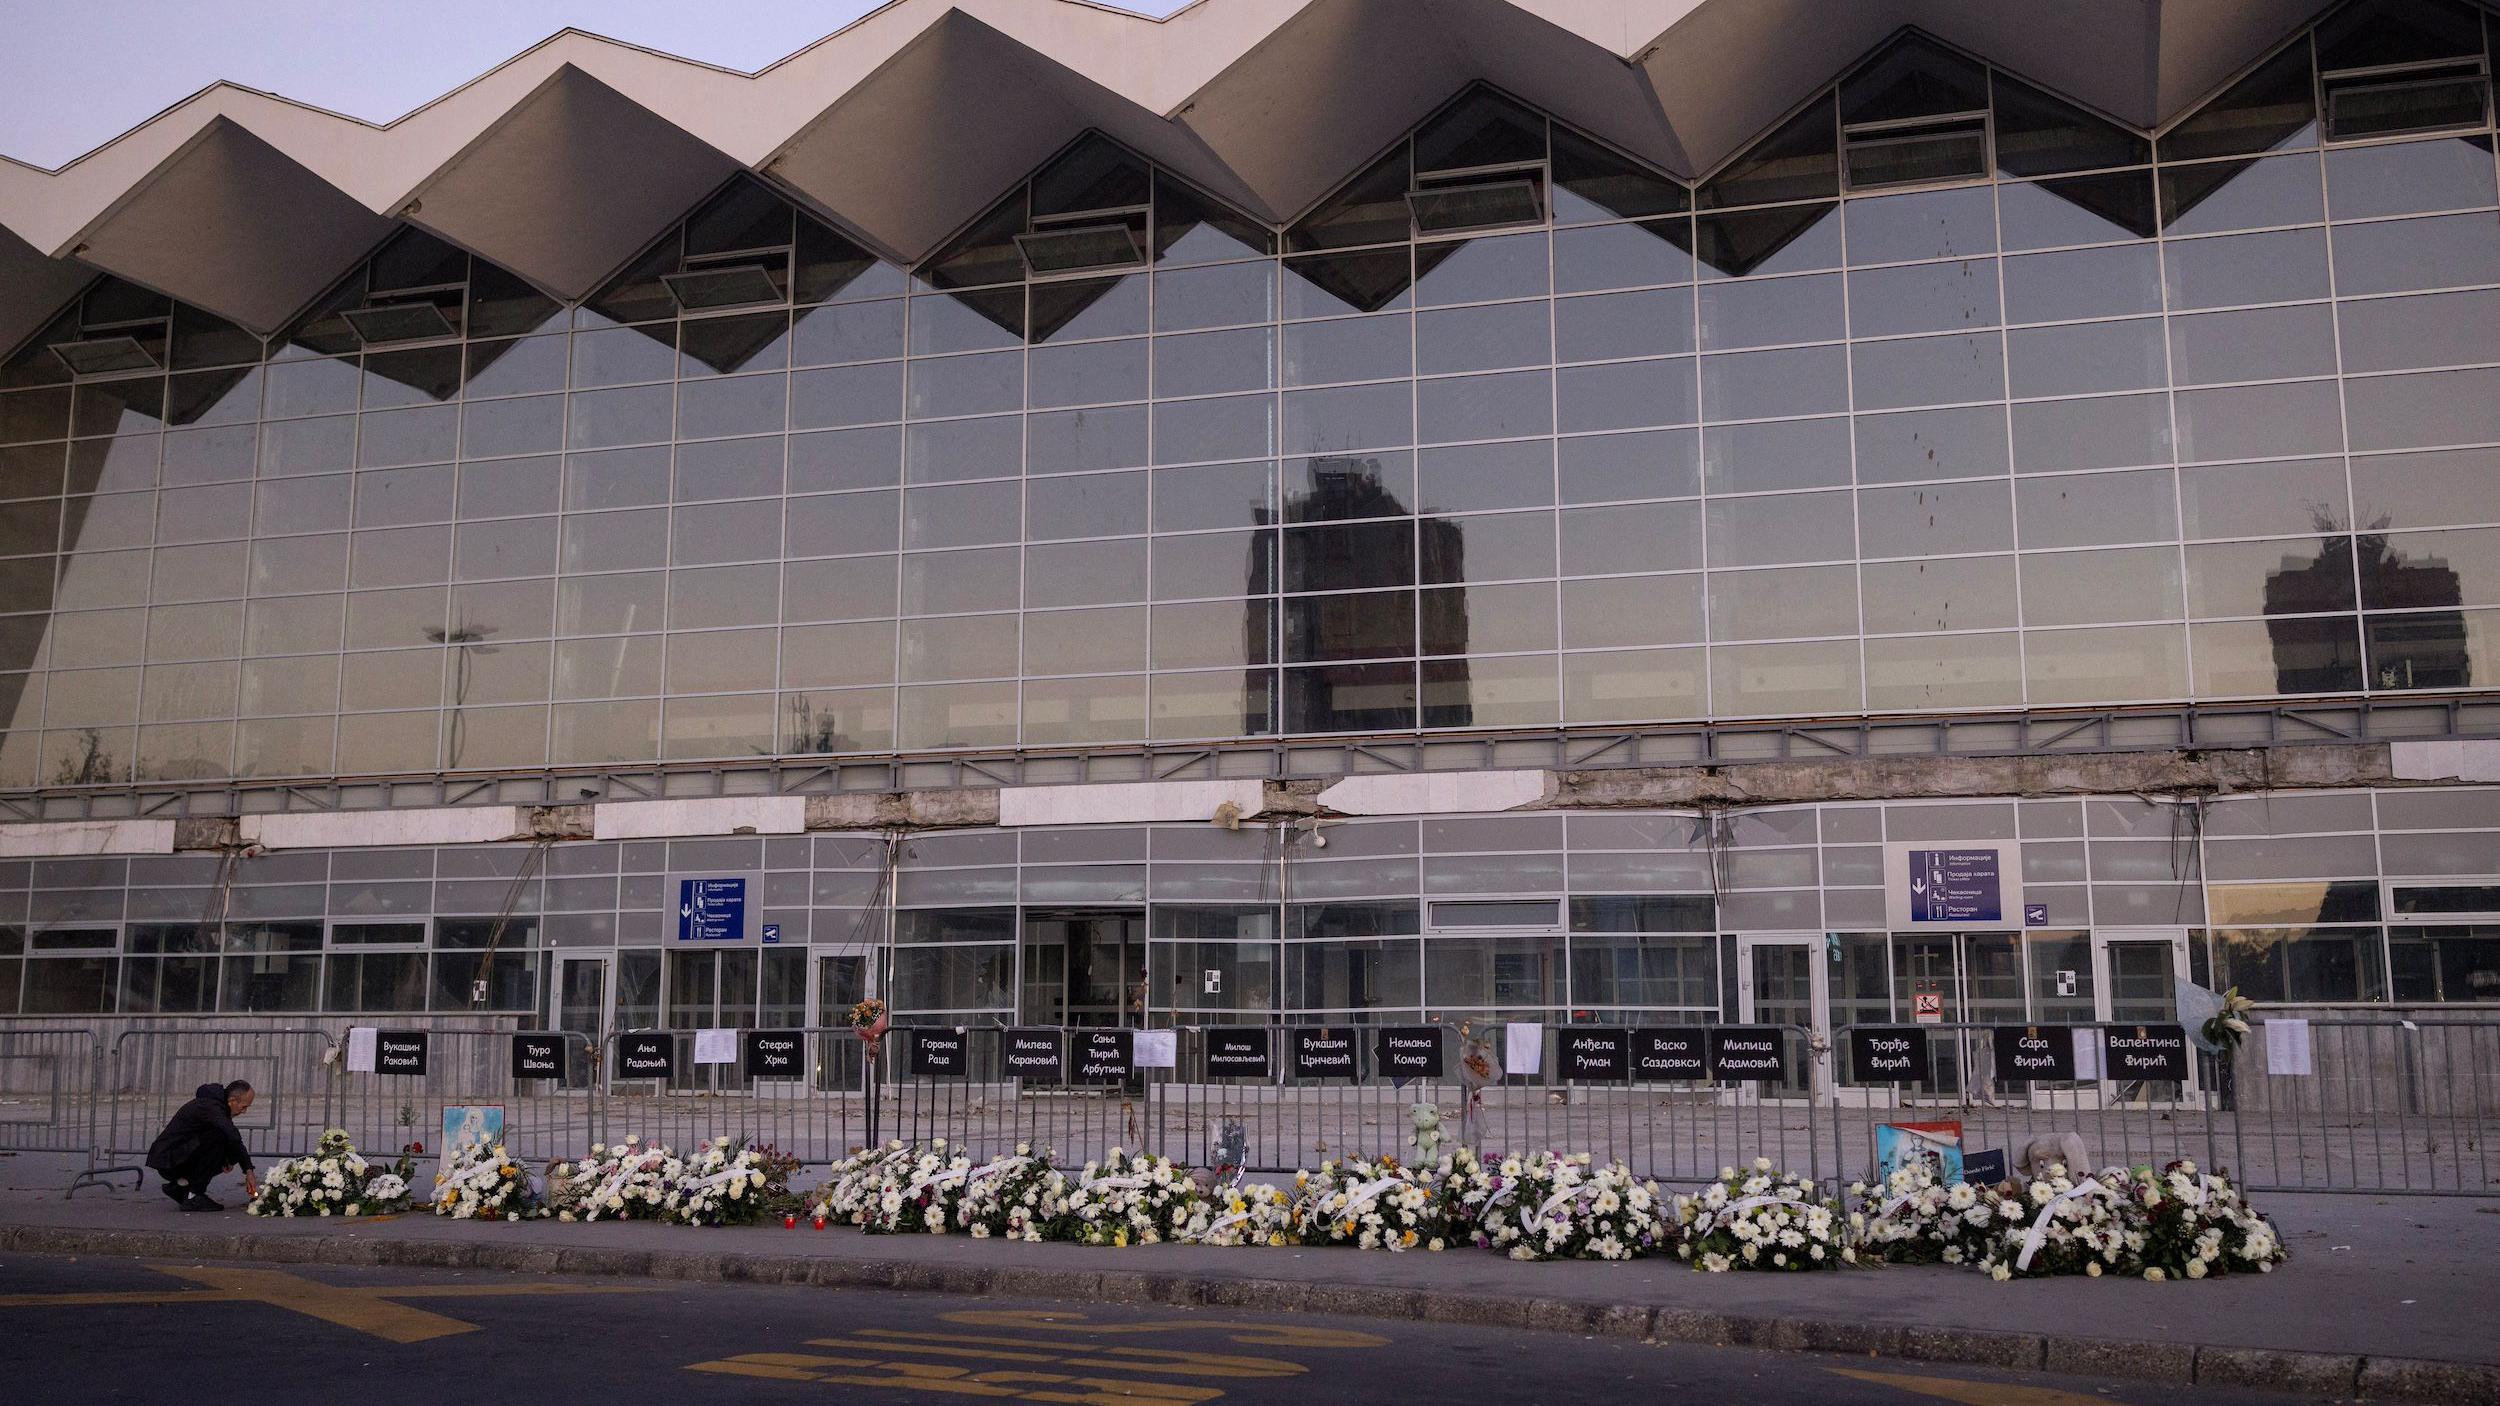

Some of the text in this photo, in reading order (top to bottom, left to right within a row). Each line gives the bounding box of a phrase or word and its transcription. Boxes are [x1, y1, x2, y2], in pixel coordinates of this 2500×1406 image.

[921, 1038, 958, 1052] Горанка
[1015, 1038, 1053, 1050] Милева
[1092, 1033, 1116, 1044] Сања
[1303, 1037, 1348, 1052] Вукашин
[1389, 1036, 1432, 1048] Немања
[1572, 1037, 1616, 1052] Анђела
[1654, 1038, 1688, 1051] Васко
[1723, 1038, 1773, 1052] Милица
[1868, 1037, 1910, 1054] Ђорђе
[2018, 1036, 2049, 1052] Сара
[2109, 1035, 2181, 1048] Валентина
[383, 1041, 421, 1054] Вукашин
[527, 1044, 551, 1057] Ђуро
[637, 1043, 657, 1053] Ања
[758, 1039, 794, 1053] Стефан
[1224, 1042, 1252, 1052] Милош
[383, 1055, 419, 1066] Раковић
[764, 1054, 788, 1068] Хрка
[927, 1053, 950, 1066] Раца
[1008, 1053, 1059, 1068] Карановић
[1087, 1048, 1120, 1062] Ћирић
[1210, 1053, 1266, 1063] Милосављевић
[1300, 1053, 1351, 1068] Црнчевић
[1393, 1053, 1428, 1068] Комар
[1576, 1054, 1611, 1070] Руман
[2013, 1054, 2056, 1070] Фирић
[2124, 1053, 2168, 1070] Фирић
[523, 1058, 555, 1069] Швоња
[626, 1057, 667, 1069] Радоњић
[1641, 1056, 1701, 1069] Саздовкси
[1718, 1056, 1780, 1070] Адамовић
[1870, 1055, 1911, 1072] Фирић
[1081, 1063, 1126, 1077] Арбутина
[681, 1310, 1394, 1406] BUS
